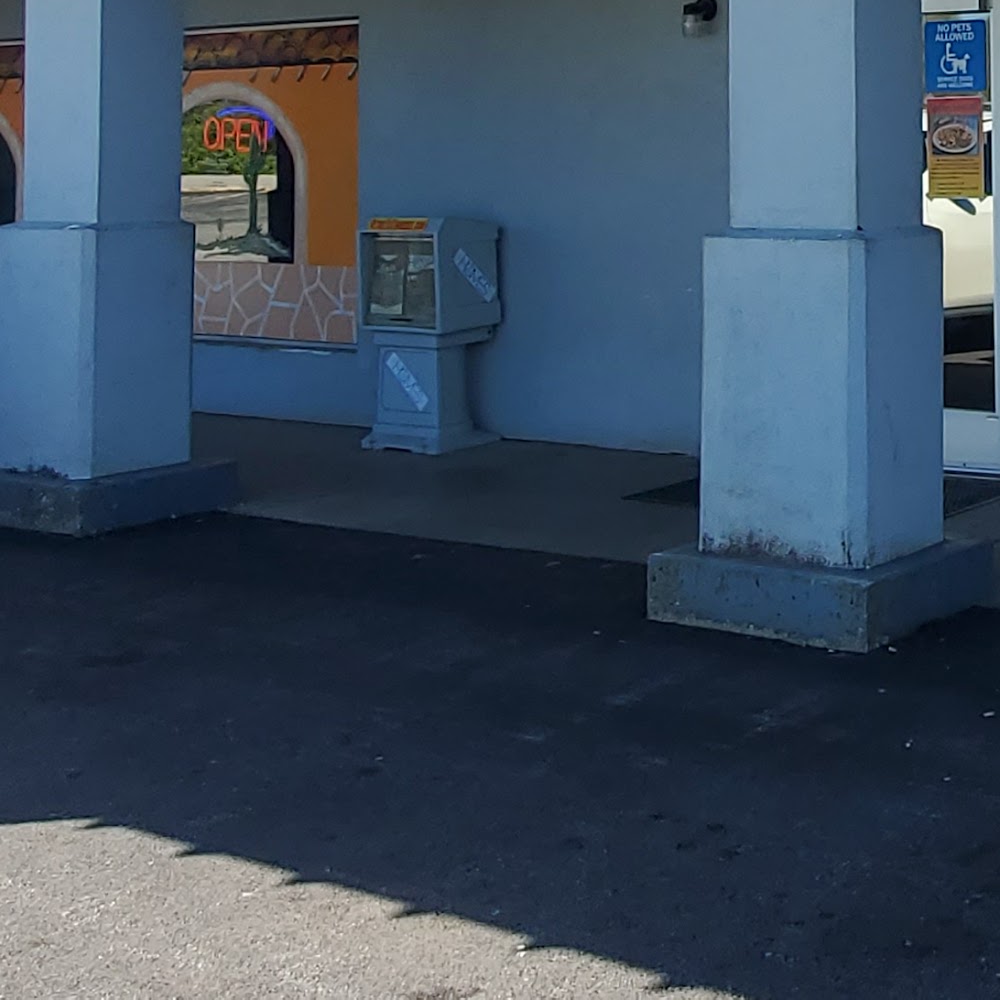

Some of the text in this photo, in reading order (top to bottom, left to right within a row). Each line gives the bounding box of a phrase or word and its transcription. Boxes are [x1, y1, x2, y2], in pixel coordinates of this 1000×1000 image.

[937, 23, 971, 32] NO PETS
[935, 32, 974, 41] ALLOWED
[204, 117, 268, 152] OPEN
